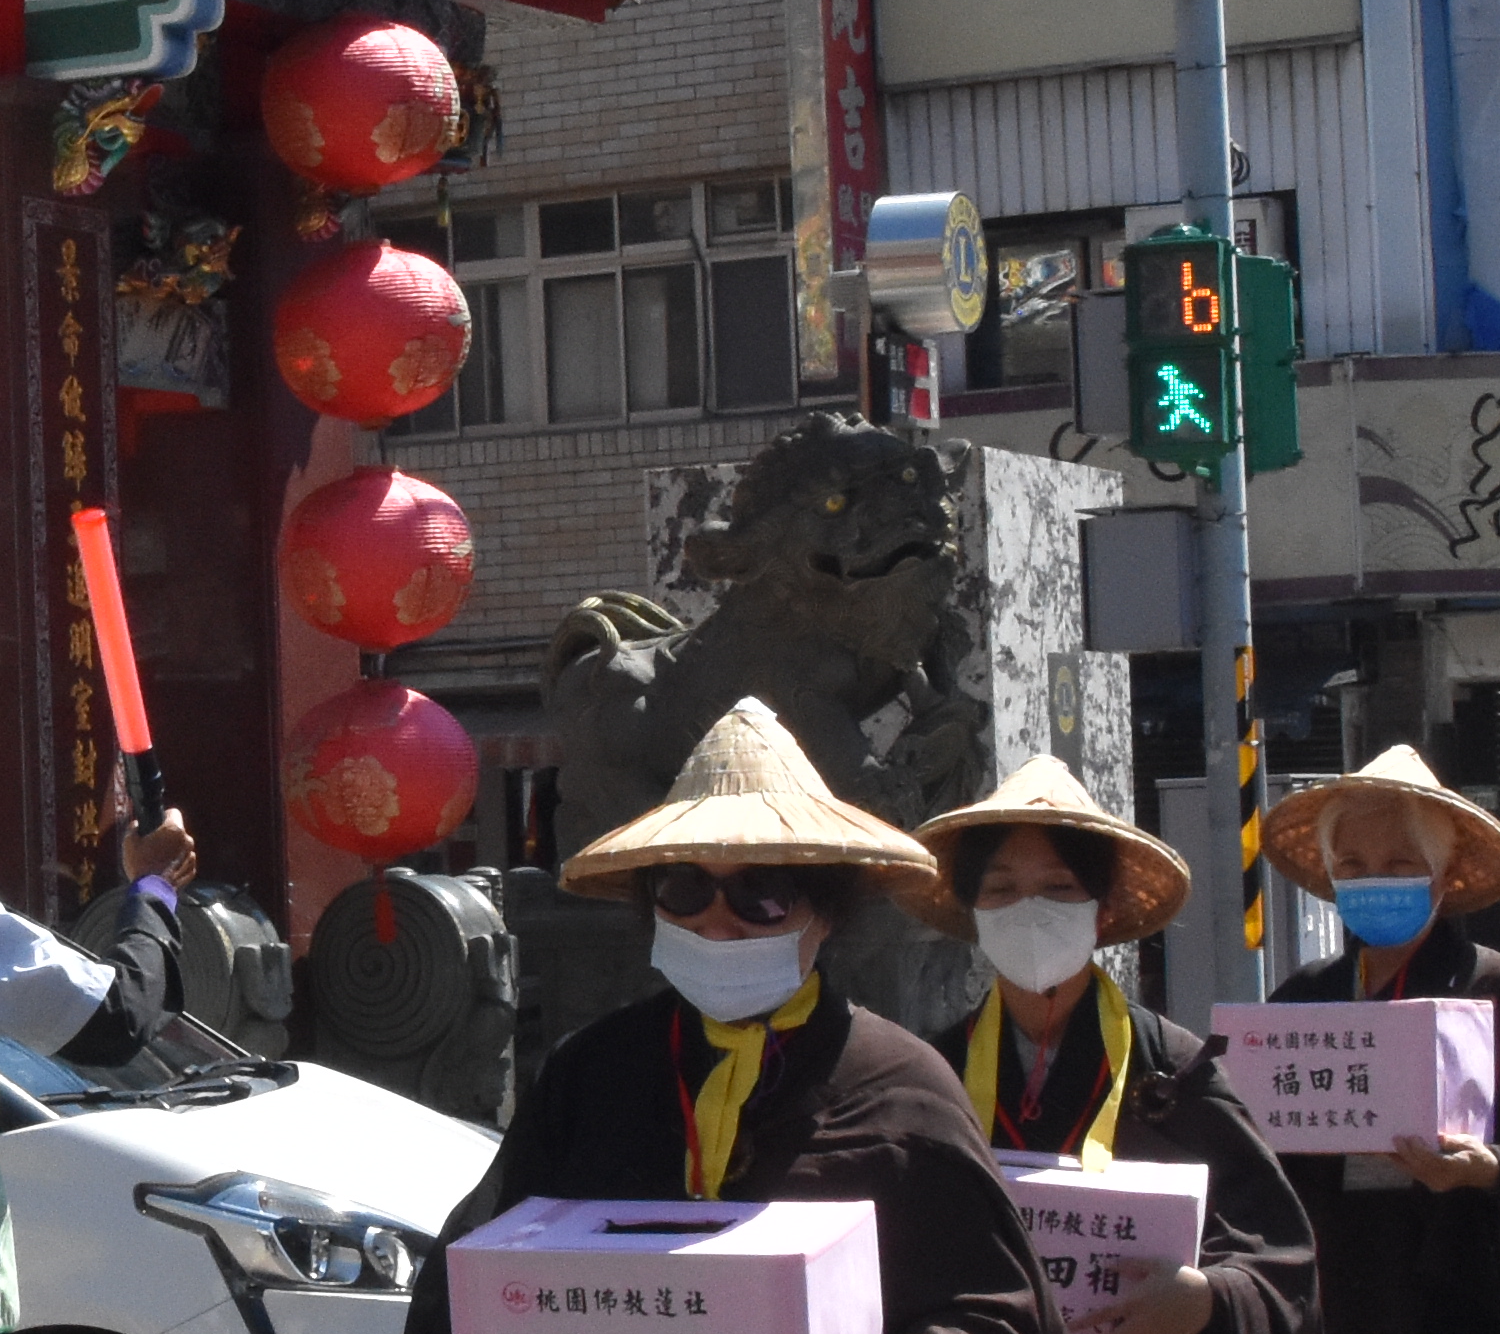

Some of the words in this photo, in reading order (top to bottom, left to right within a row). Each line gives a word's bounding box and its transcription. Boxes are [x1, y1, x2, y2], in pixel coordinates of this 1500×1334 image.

[1272, 1063, 1370, 1097] 福田箱
[1020, 1207, 1137, 1241] 園佛教蓮社
[1041, 1252, 1121, 1296] 田箱
[535, 1286, 710, 1318] 桃園佛教蓮社
